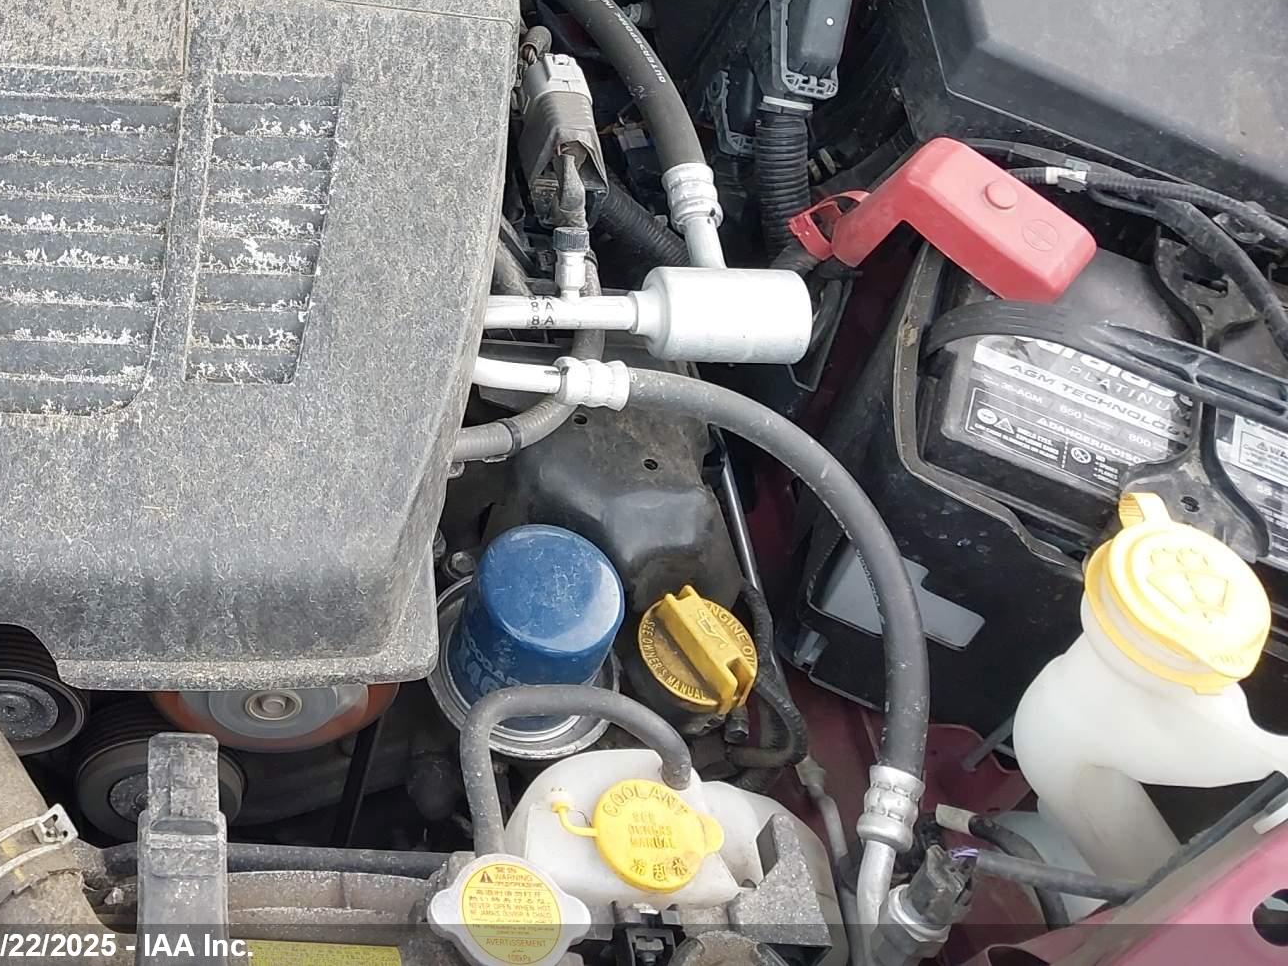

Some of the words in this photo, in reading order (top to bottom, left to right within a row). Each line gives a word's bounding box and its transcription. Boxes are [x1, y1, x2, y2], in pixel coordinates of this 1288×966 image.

[1010, 363, 1055, 385] AGM
[1062, 383, 1192, 436] TECHNOLOGY
[1069, 365, 1192, 420] PLATINUM
[642, 619, 656, 636] SEE
[641, 637, 669, 680] OWNER'S
[665, 674, 707, 701] MANUAL
[602, 784, 689, 818] COOLANT
[629, 836, 676, 850] MANUAL
[494, 873, 534, 883] WARNING
[485, 938, 546, 948] AVERTISSEMENT
